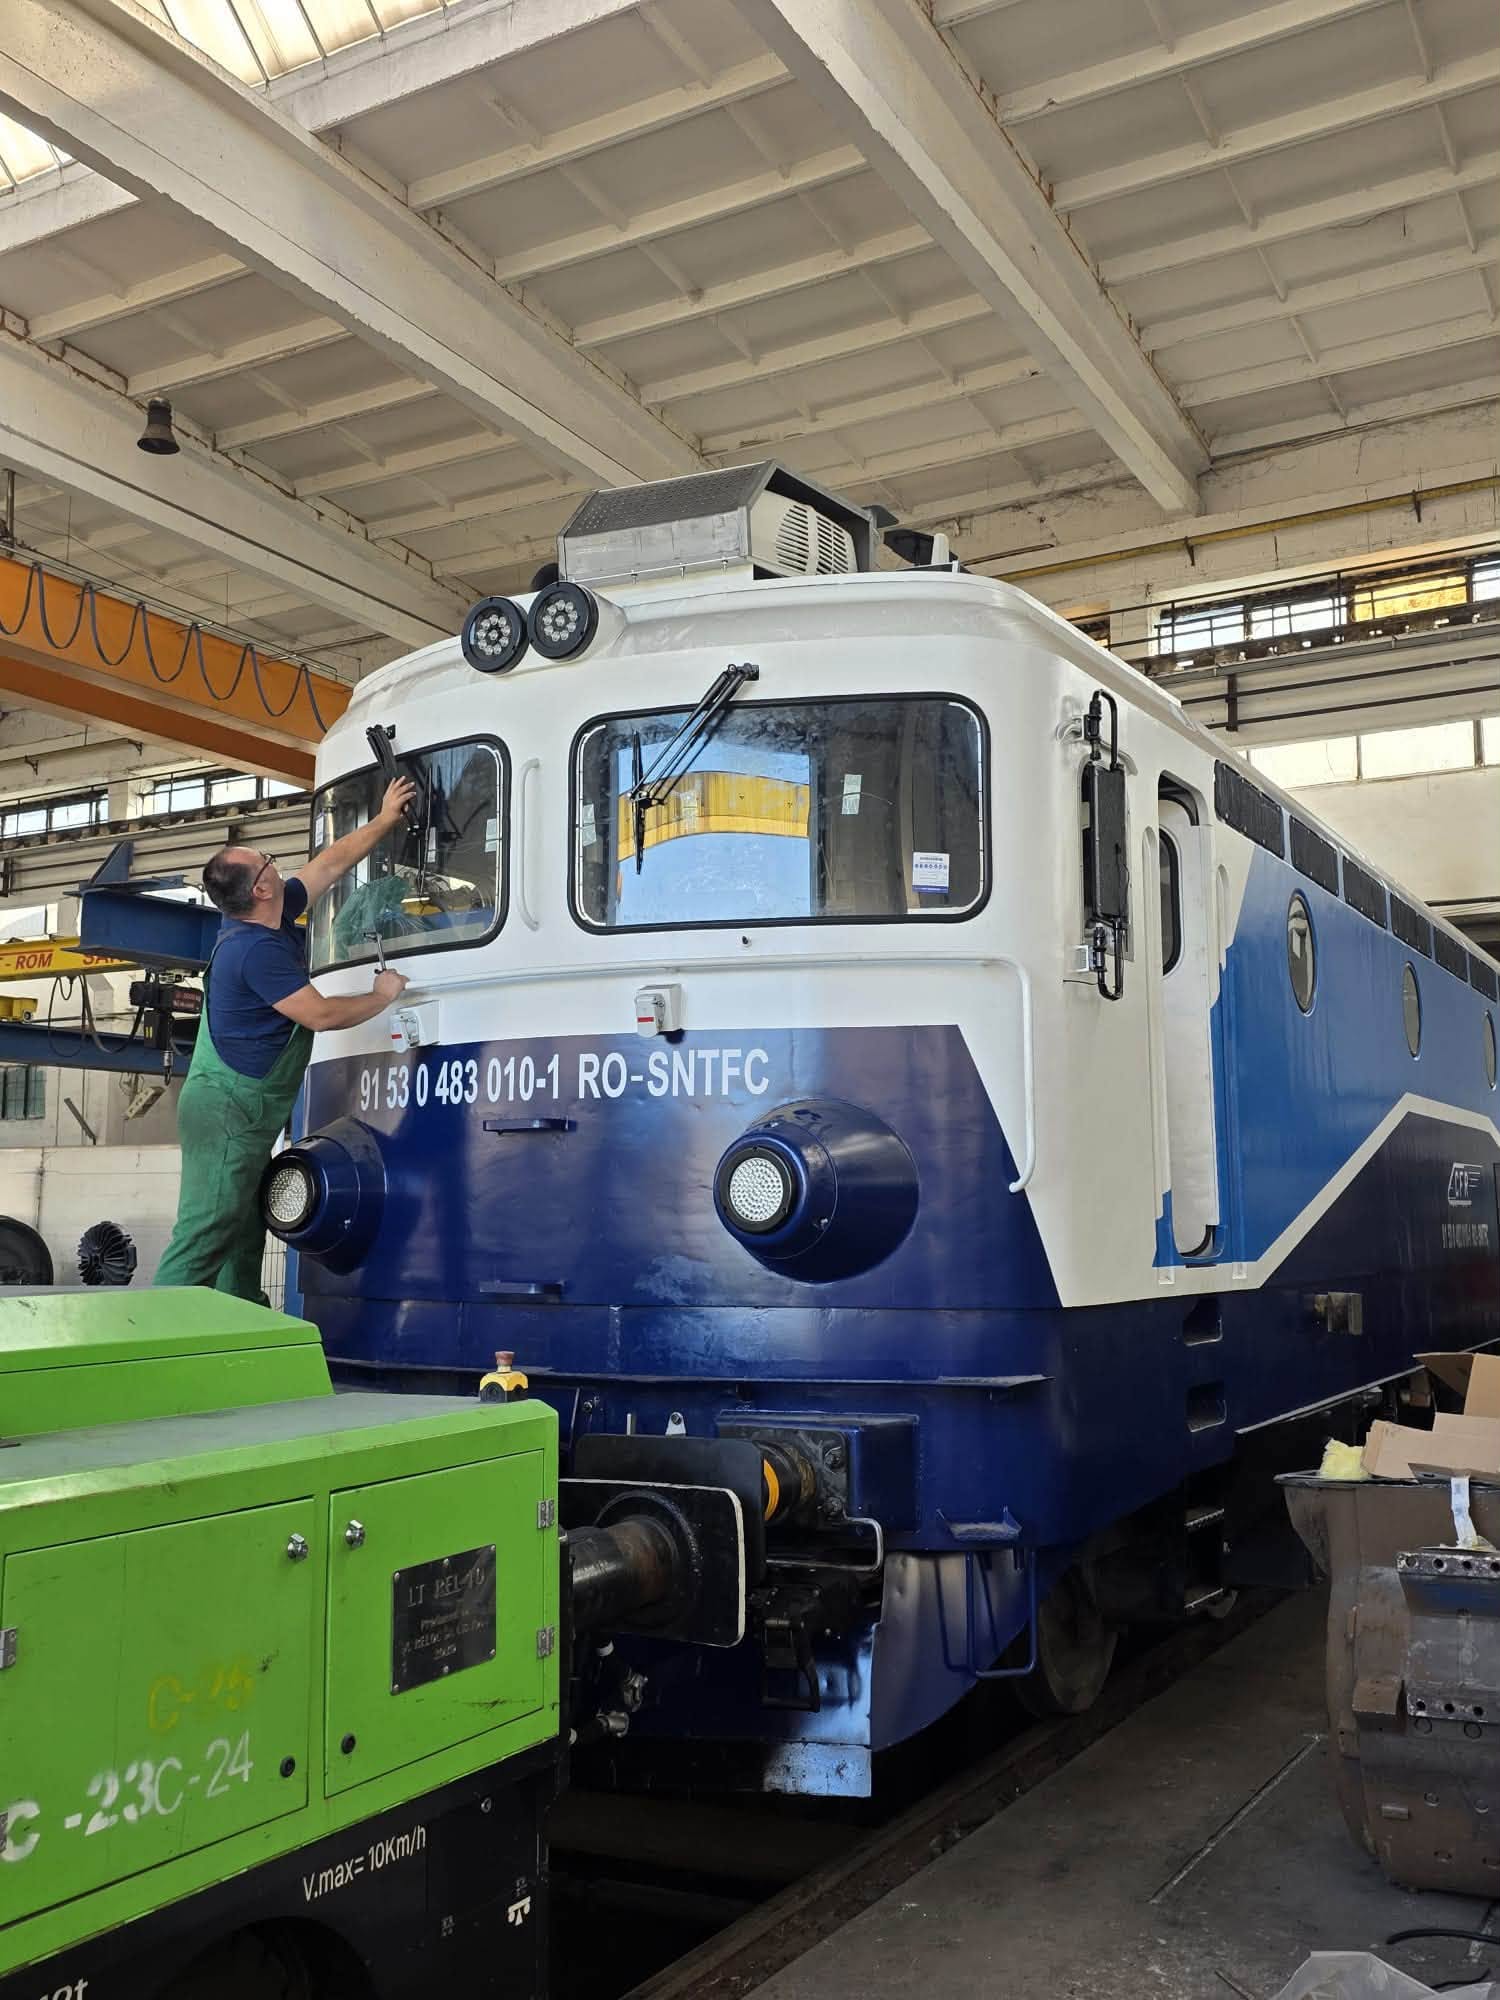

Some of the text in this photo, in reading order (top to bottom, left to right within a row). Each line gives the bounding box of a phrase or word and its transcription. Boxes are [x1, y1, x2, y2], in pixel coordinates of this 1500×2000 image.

[361, 1048, 769, 1111] 91 53 0 483 010-1 RO-SNTFC
